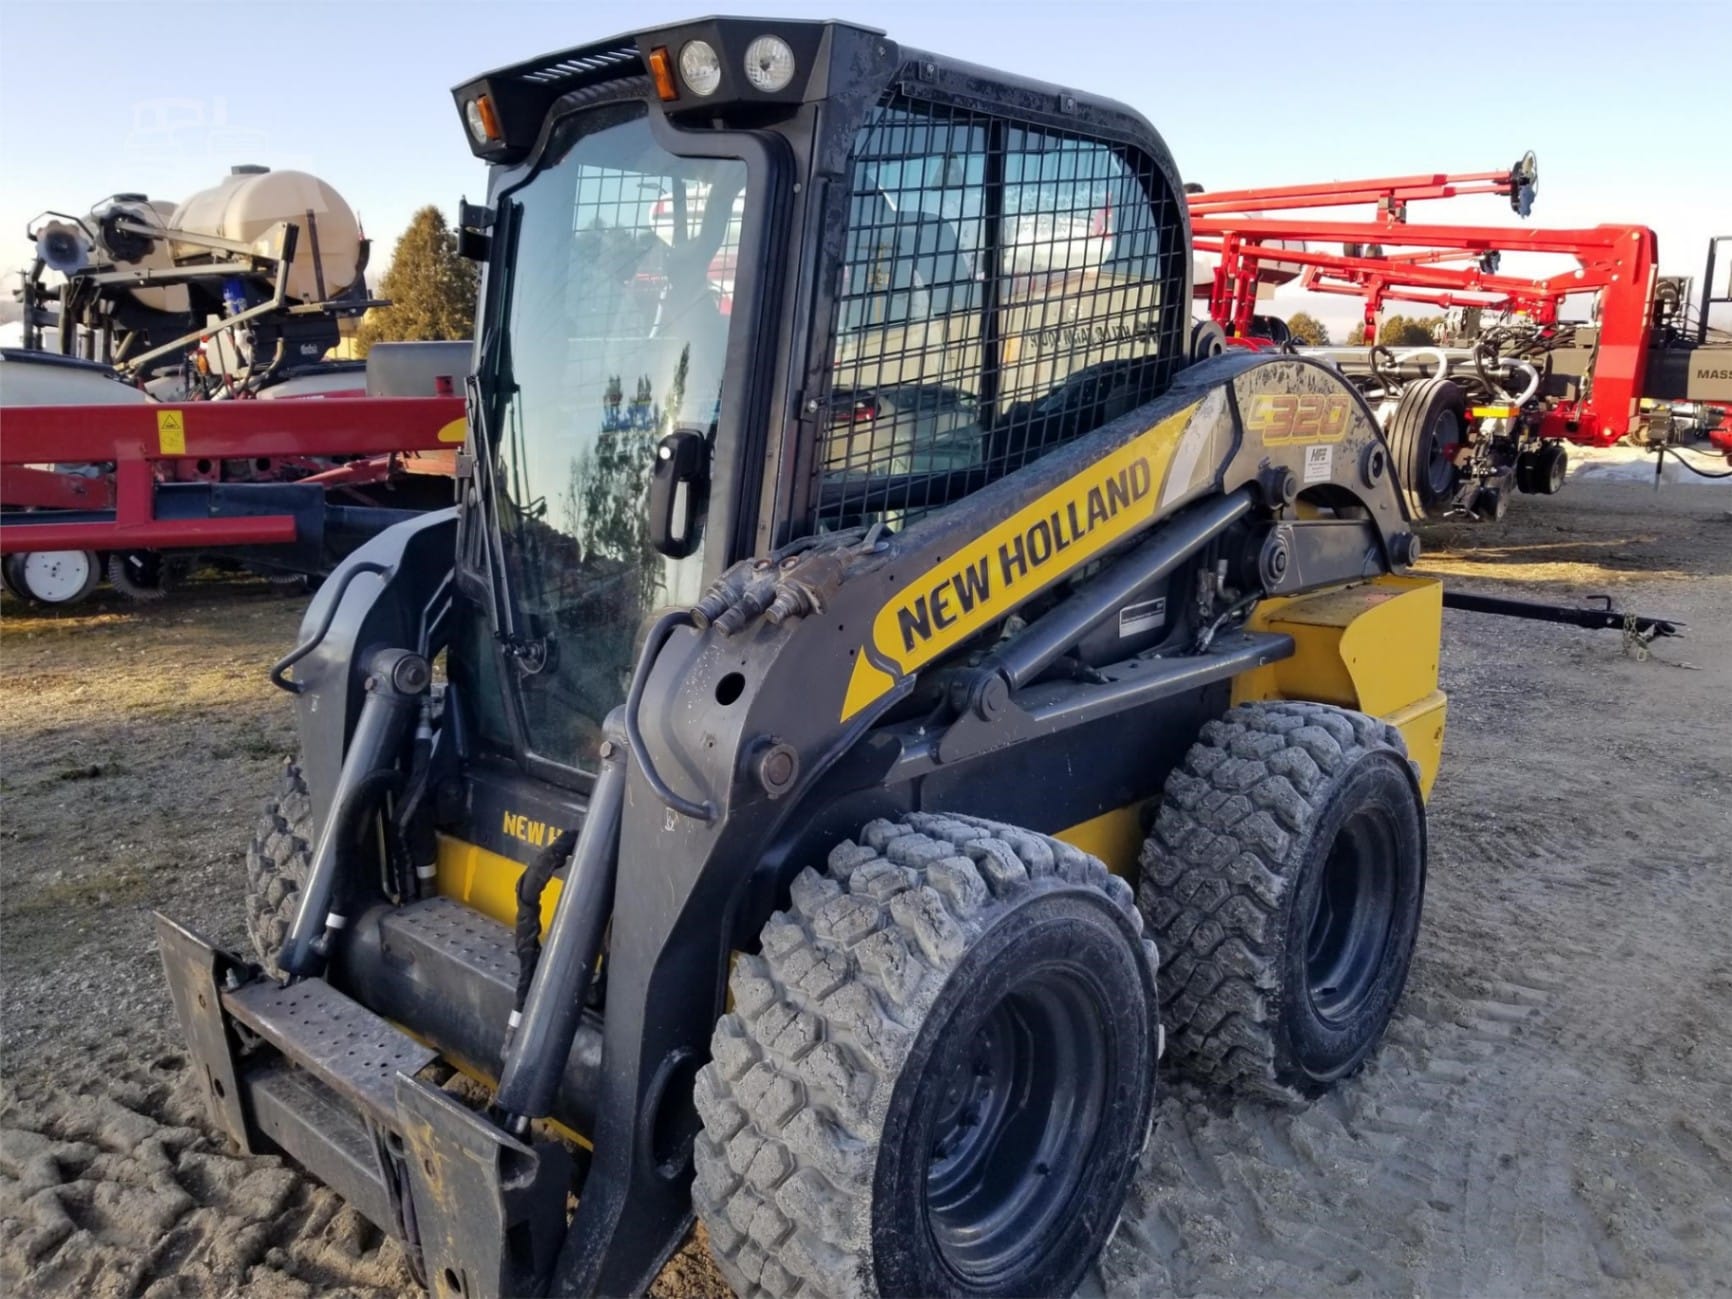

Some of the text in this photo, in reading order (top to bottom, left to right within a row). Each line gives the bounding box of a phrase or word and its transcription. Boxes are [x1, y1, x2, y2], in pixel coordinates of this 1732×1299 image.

[896, 457, 1152, 652] NEW HOLLAND
[503, 810, 546, 847] NEW
